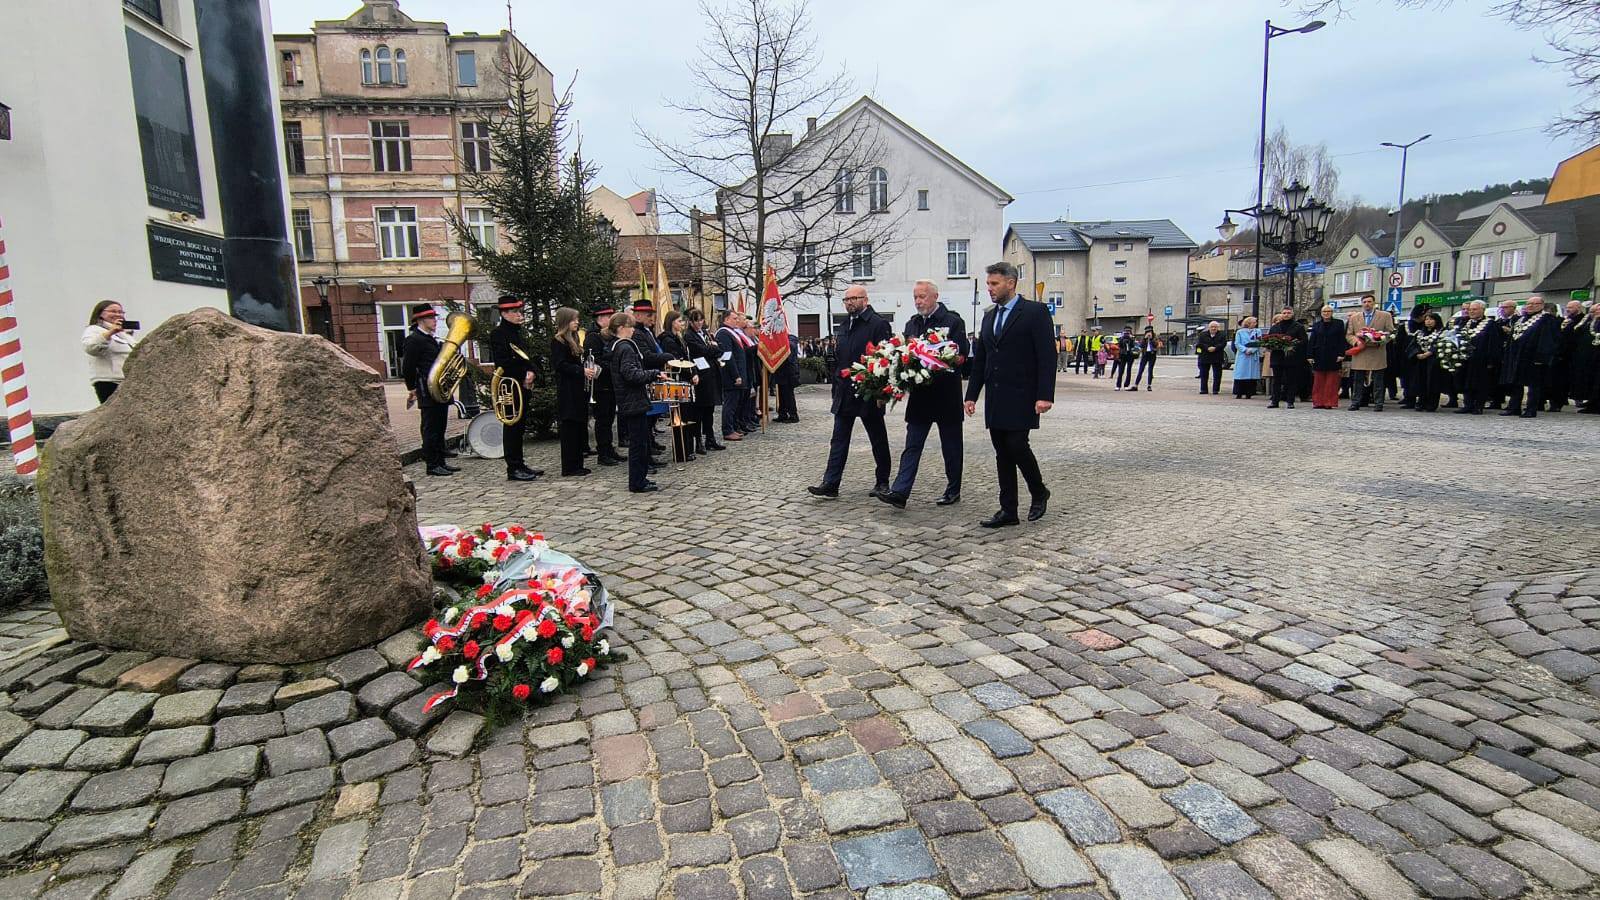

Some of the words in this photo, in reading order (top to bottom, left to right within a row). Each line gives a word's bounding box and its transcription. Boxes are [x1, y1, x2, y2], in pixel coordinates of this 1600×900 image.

[153, 235, 186, 246] WDZIĘCZNI
[187, 242, 201, 250] BOGU
[179, 250, 214, 261] PONTYFIKATU
[179, 259, 193, 268] JANA
